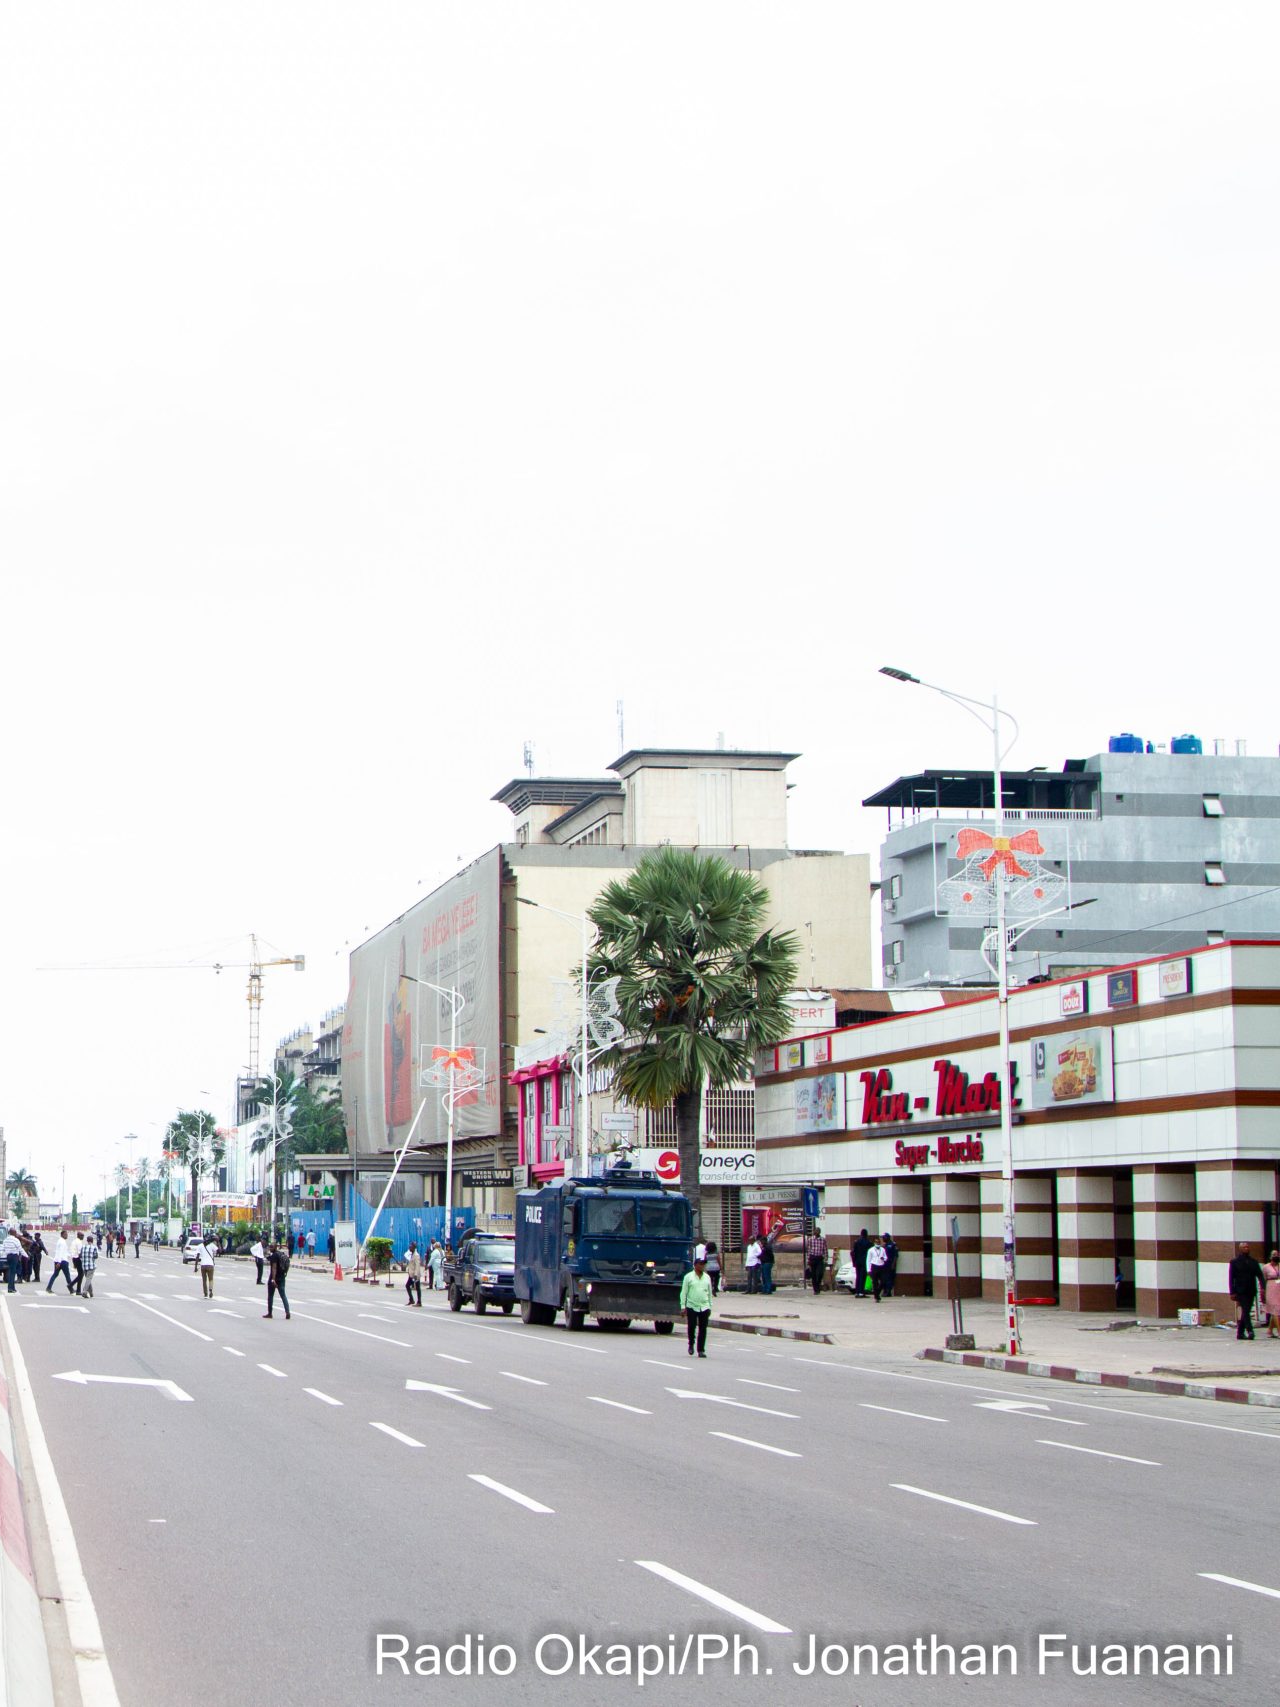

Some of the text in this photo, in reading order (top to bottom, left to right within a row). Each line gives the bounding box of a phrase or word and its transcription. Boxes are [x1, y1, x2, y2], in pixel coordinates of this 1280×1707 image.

[1063, 996, 1079, 1010] DOUX
[860, 1068, 913, 1124] Kin
[933, 1059, 1022, 1116] Mart
[699, 1154, 755, 1171] oneyG
[494, 1170, 511, 1179] WU
[777, 1190, 797, 1199] PRESSE
[525, 1205, 542, 1223] POLICE
